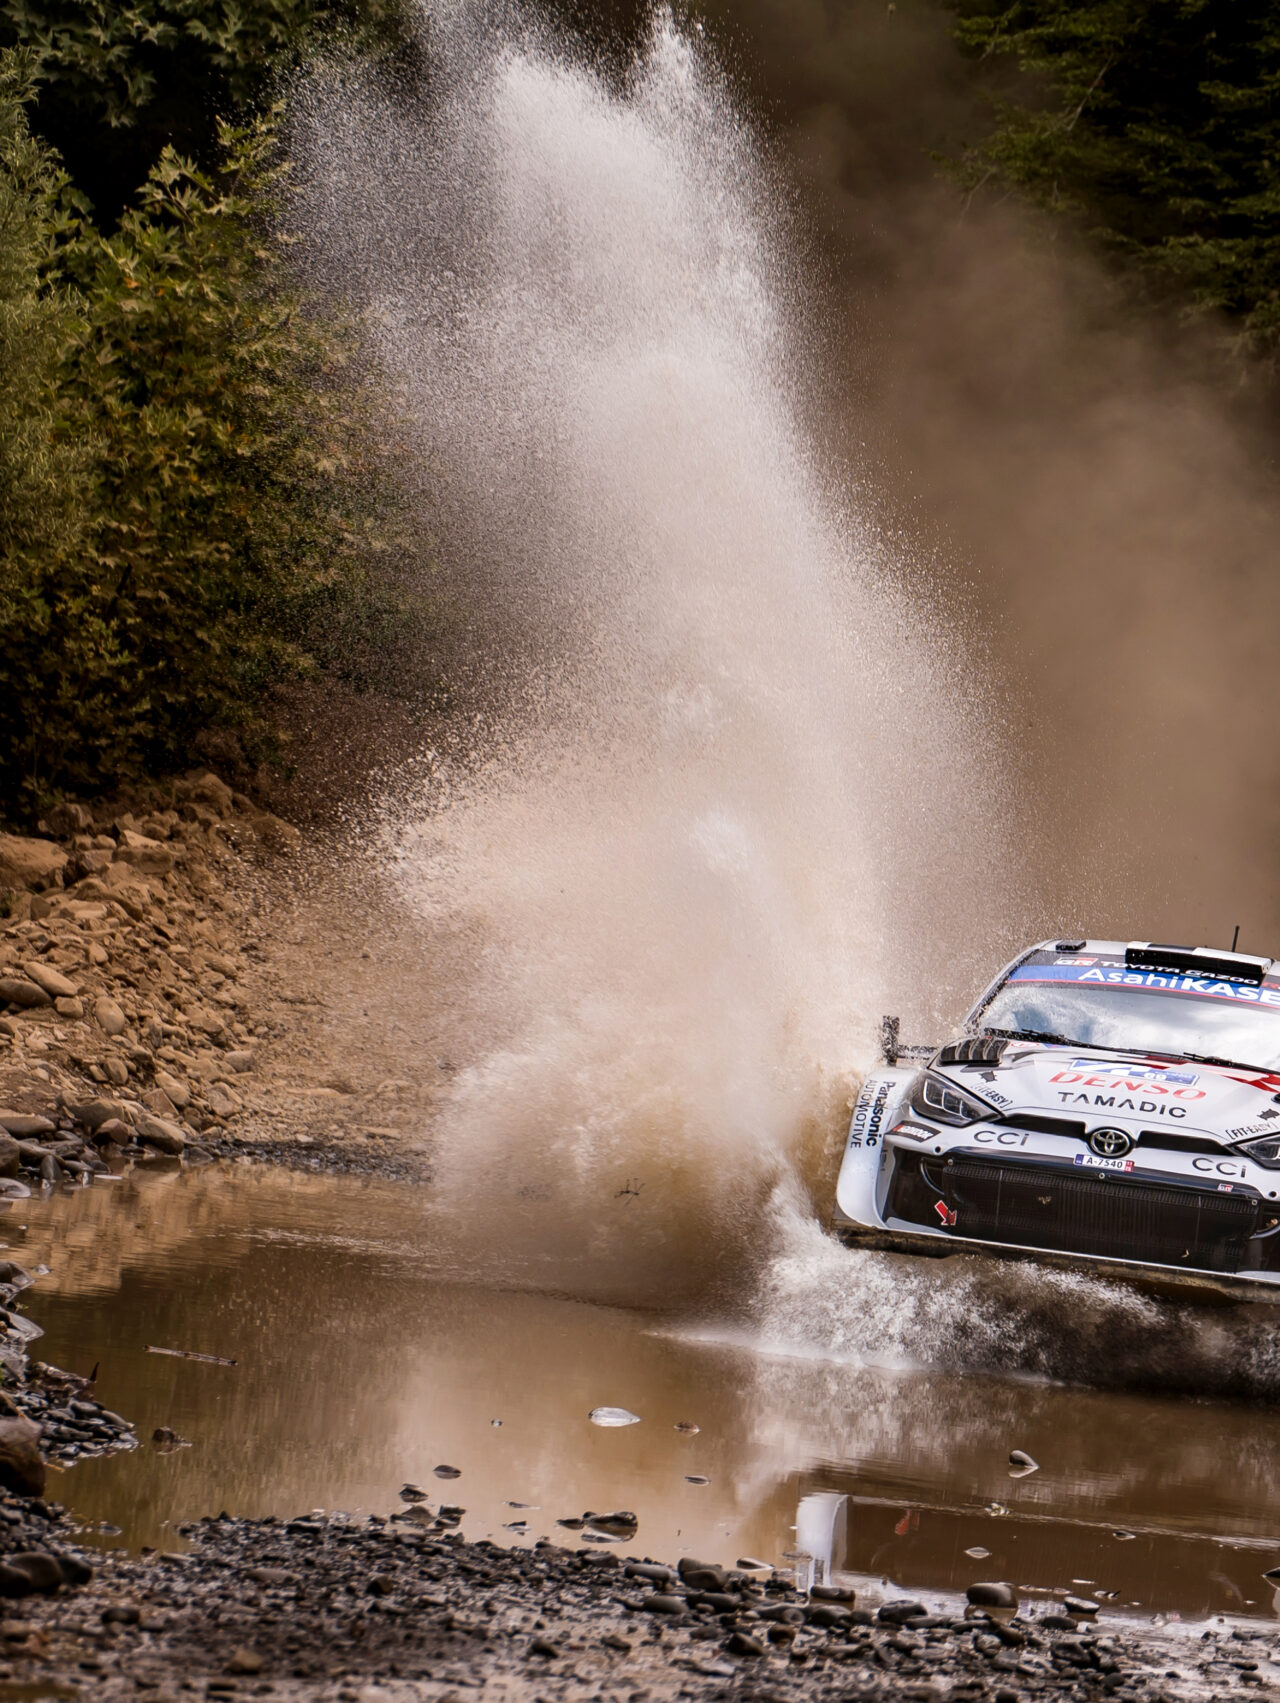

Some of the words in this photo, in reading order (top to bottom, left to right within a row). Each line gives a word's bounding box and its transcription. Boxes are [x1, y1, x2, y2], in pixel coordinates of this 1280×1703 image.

[1101, 960, 1179, 974] TOYOTA
[1180, 969, 1259, 985] GAZOO
[1048, 1072, 1207, 1100] DENSO
[850, 1079, 877, 1149] AUTOMOTIVE
[866, 1081, 897, 1147] Panasonic
[1058, 1091, 1188, 1118] TAMADIC
[1086, 1156, 1123, 1168] A-7540
